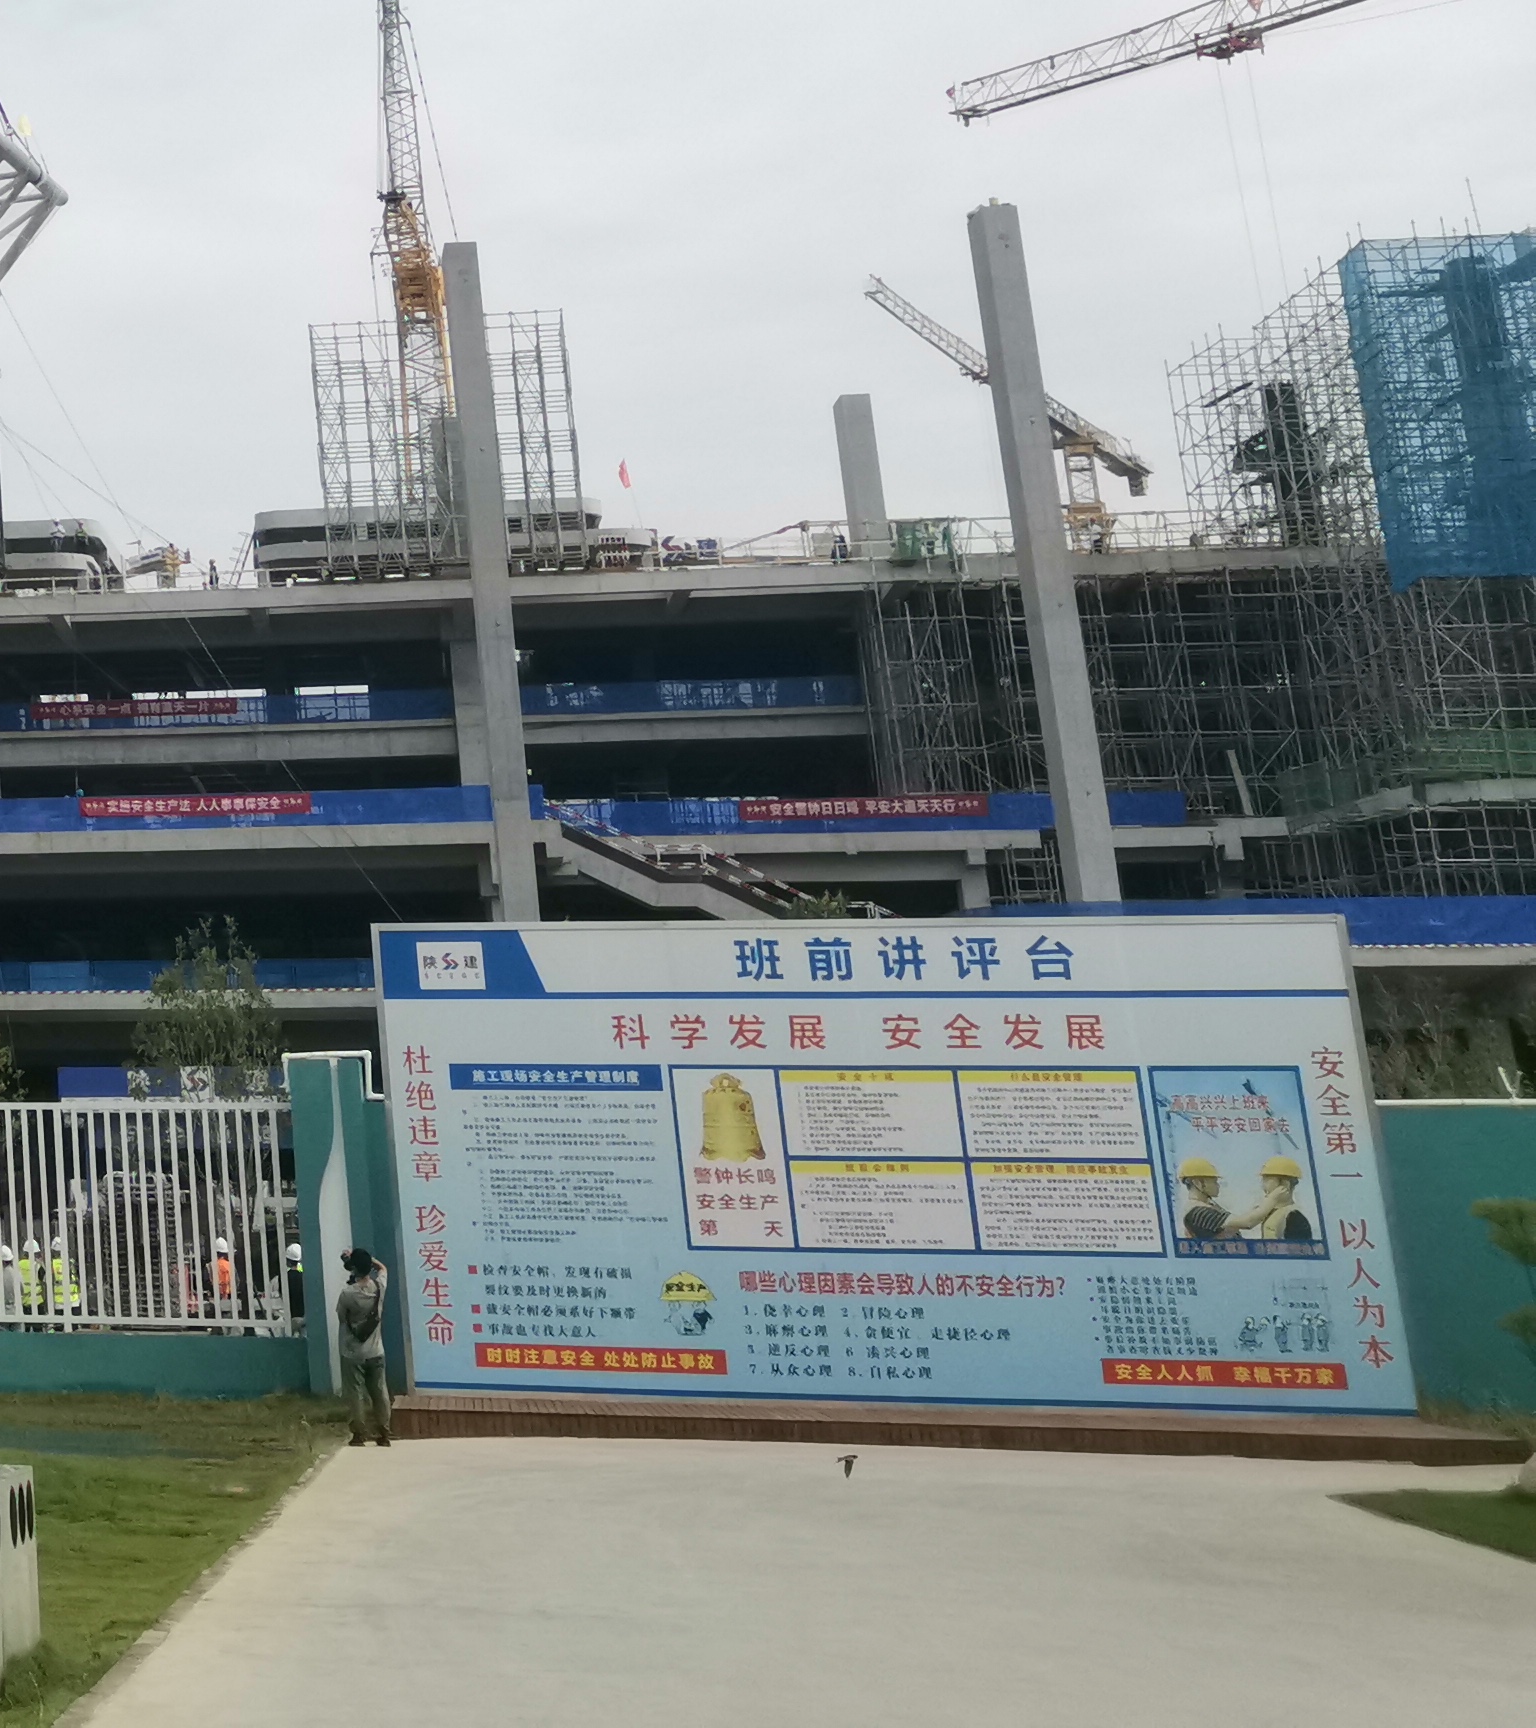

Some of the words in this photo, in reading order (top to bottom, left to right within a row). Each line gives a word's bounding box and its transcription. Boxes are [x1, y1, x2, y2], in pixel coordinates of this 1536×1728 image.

[734, 934, 1074, 982] 班前讲评台
[611, 1014, 826, 1050] 科学发展
[882, 1013, 1106, 1051] 安全发展
[402, 1045, 443, 1182] 杜绝违章
[1170, 1094, 1270, 1111] 高高兴兴上班来
[1191, 1117, 1290, 1134] 平平安安回家去
[692, 1167, 777, 1187] 警钟长鸣
[695, 1192, 779, 1212] 安全生产
[1310, 1046, 1364, 1179] 安全第一
[1338, 1217, 1394, 1369] 以人为本
[414, 1204, 458, 1347] 珍爱生命
[486, 1347, 596, 1367] 时时注意安全
[604, 1351, 715, 1370] 处处防止事故
[1114, 1363, 1214, 1382] 安全人人抓
[1233, 1366, 1335, 1385] 幸福千万家
